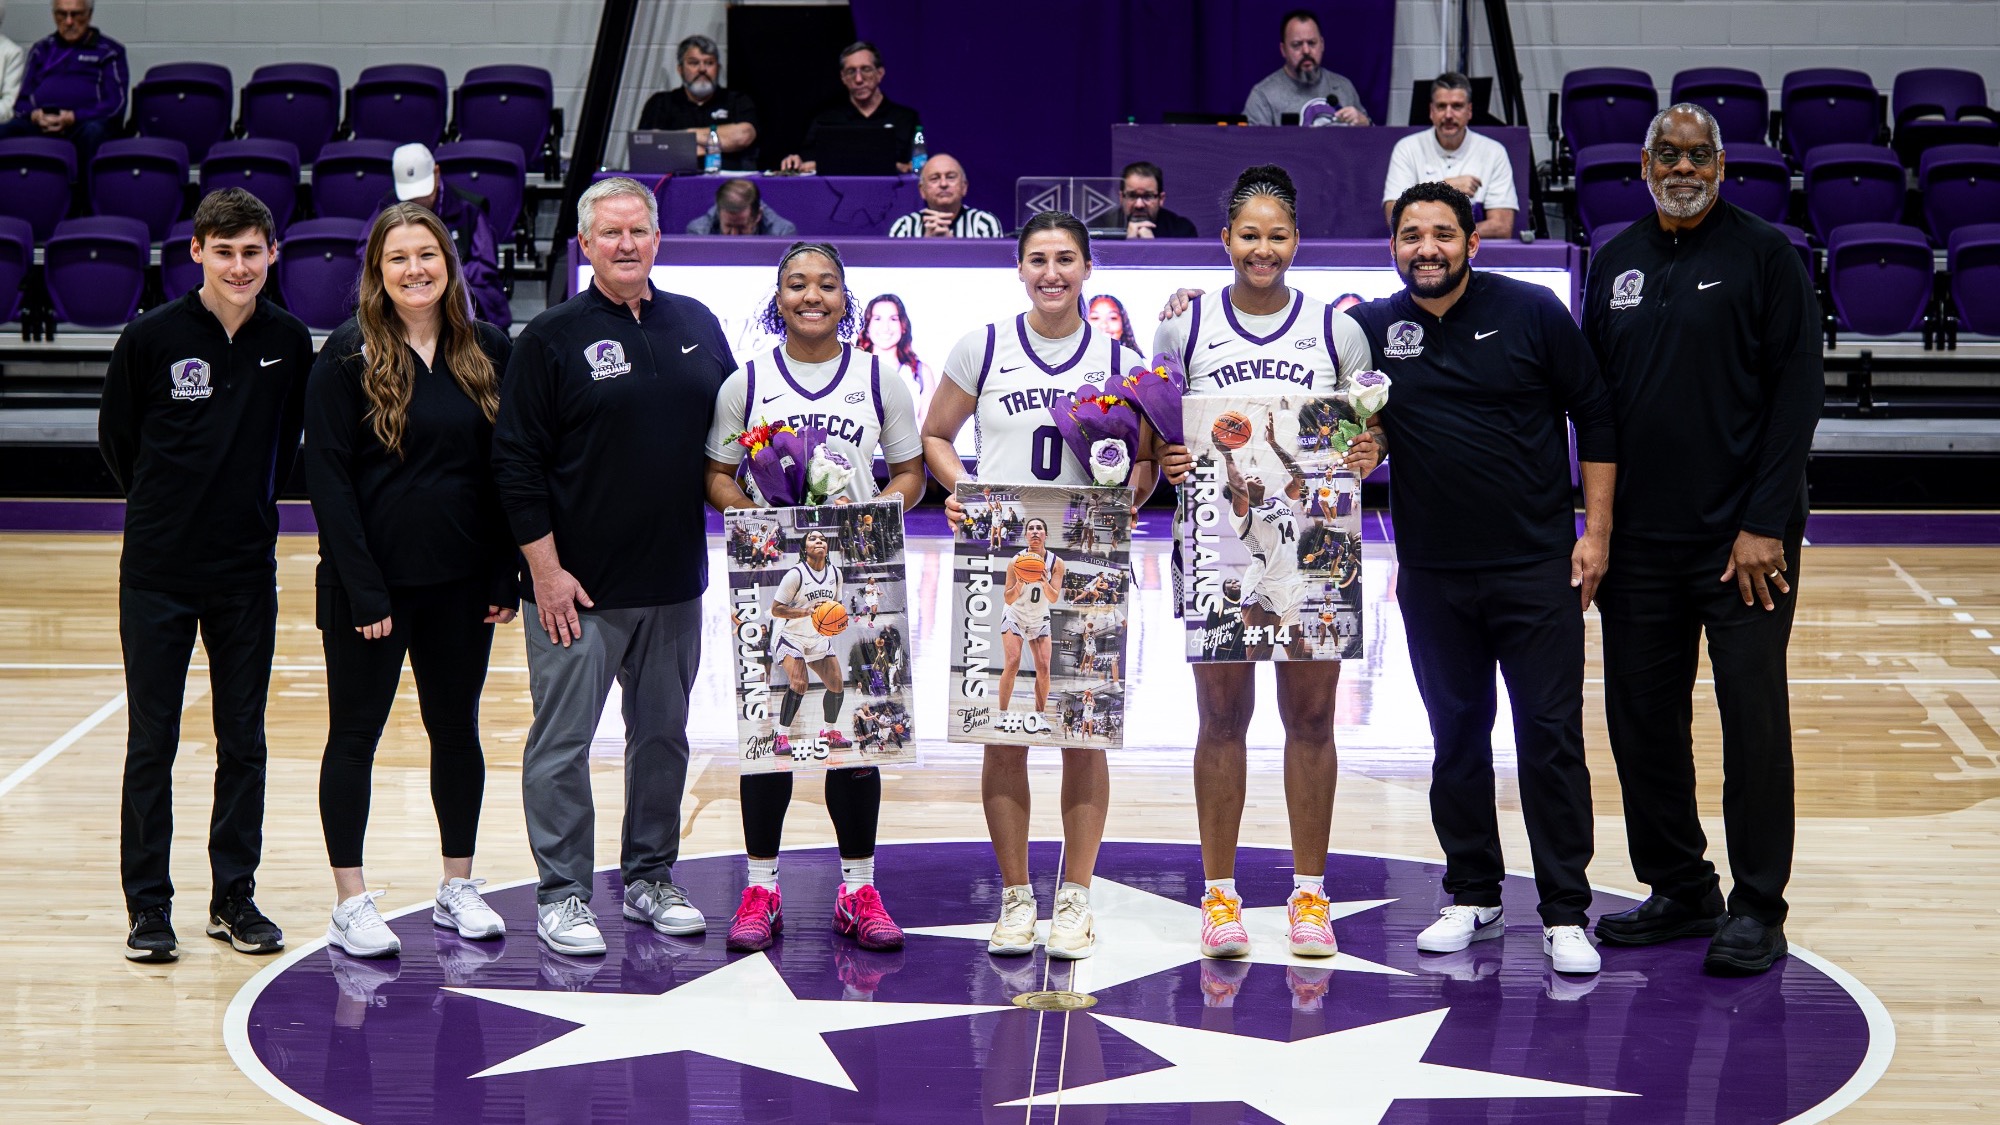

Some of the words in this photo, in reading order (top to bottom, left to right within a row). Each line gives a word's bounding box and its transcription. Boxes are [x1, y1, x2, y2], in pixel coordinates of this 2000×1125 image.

[1386, 348, 1421, 356] TROJANS
[593, 363, 630, 378] TROJANS
[1208, 359, 1315, 390] TREVECCA
[174, 388, 212, 397] TROJANS
[999, 388, 1077, 416] TREVE
[783, 413, 865, 448] EVECCA
[1031, 425, 1064, 481] 0
[1193, 460, 1220, 614] TROJANS
[1278, 520, 1296, 545] 14
[1030, 587, 1041, 603] 0
[963, 554, 994, 699] TROJANS
[1242, 624, 1293, 646] #14
[735, 582, 768, 722] TROJANS
[1003, 712, 1040, 734] #0
[791, 737, 830, 761] #5
